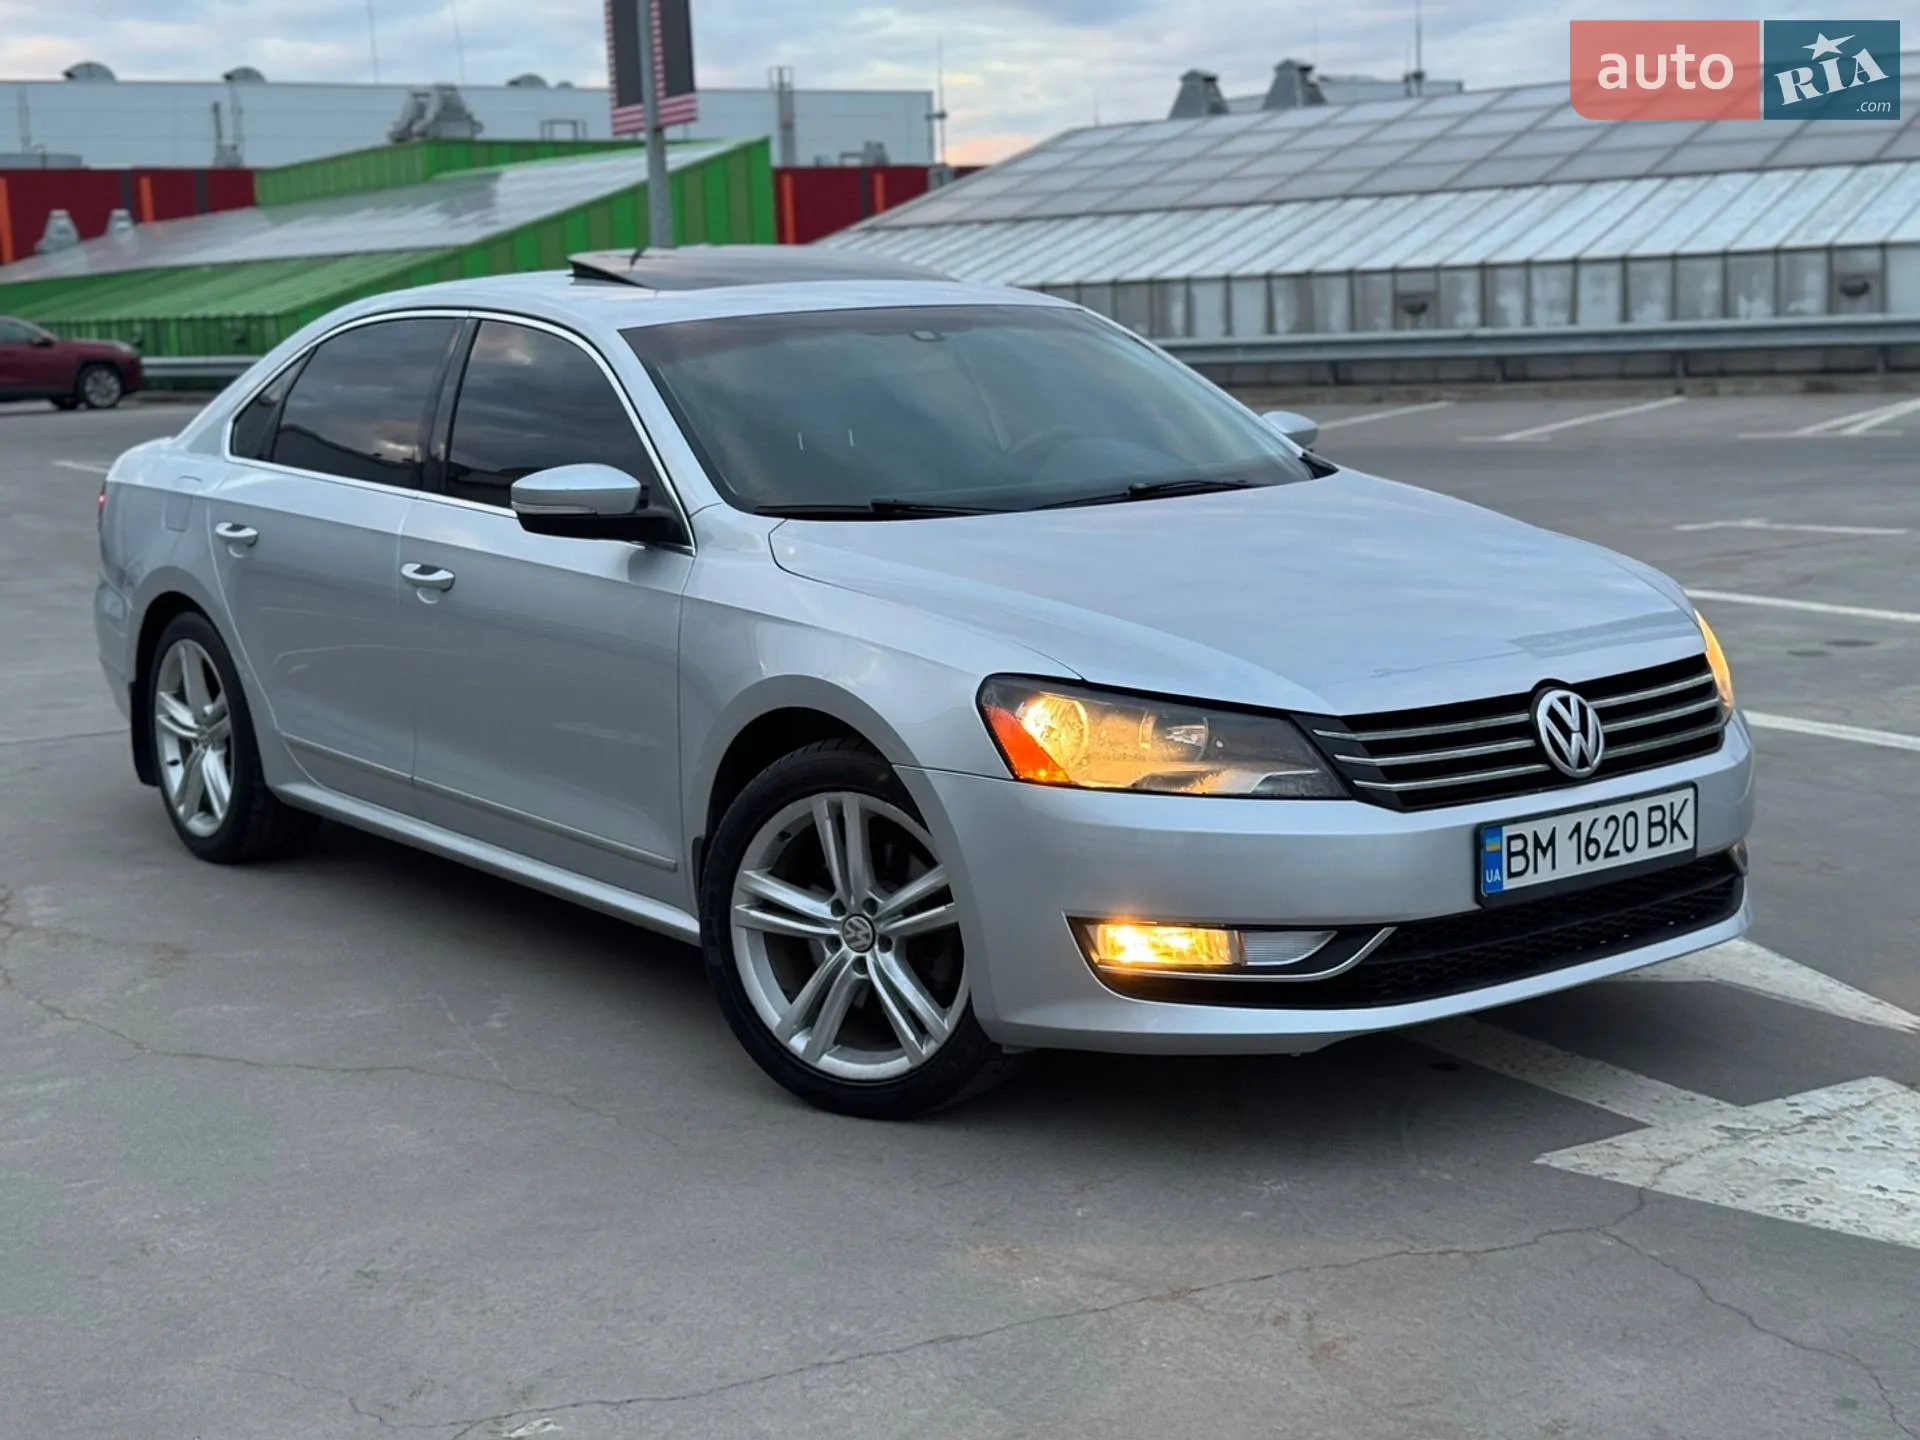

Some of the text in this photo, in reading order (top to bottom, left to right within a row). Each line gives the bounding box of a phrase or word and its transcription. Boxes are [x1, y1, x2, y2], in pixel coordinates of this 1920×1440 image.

[1506, 798, 1689, 879] BM 1620 BK
[1485, 868, 1501, 883] UA
